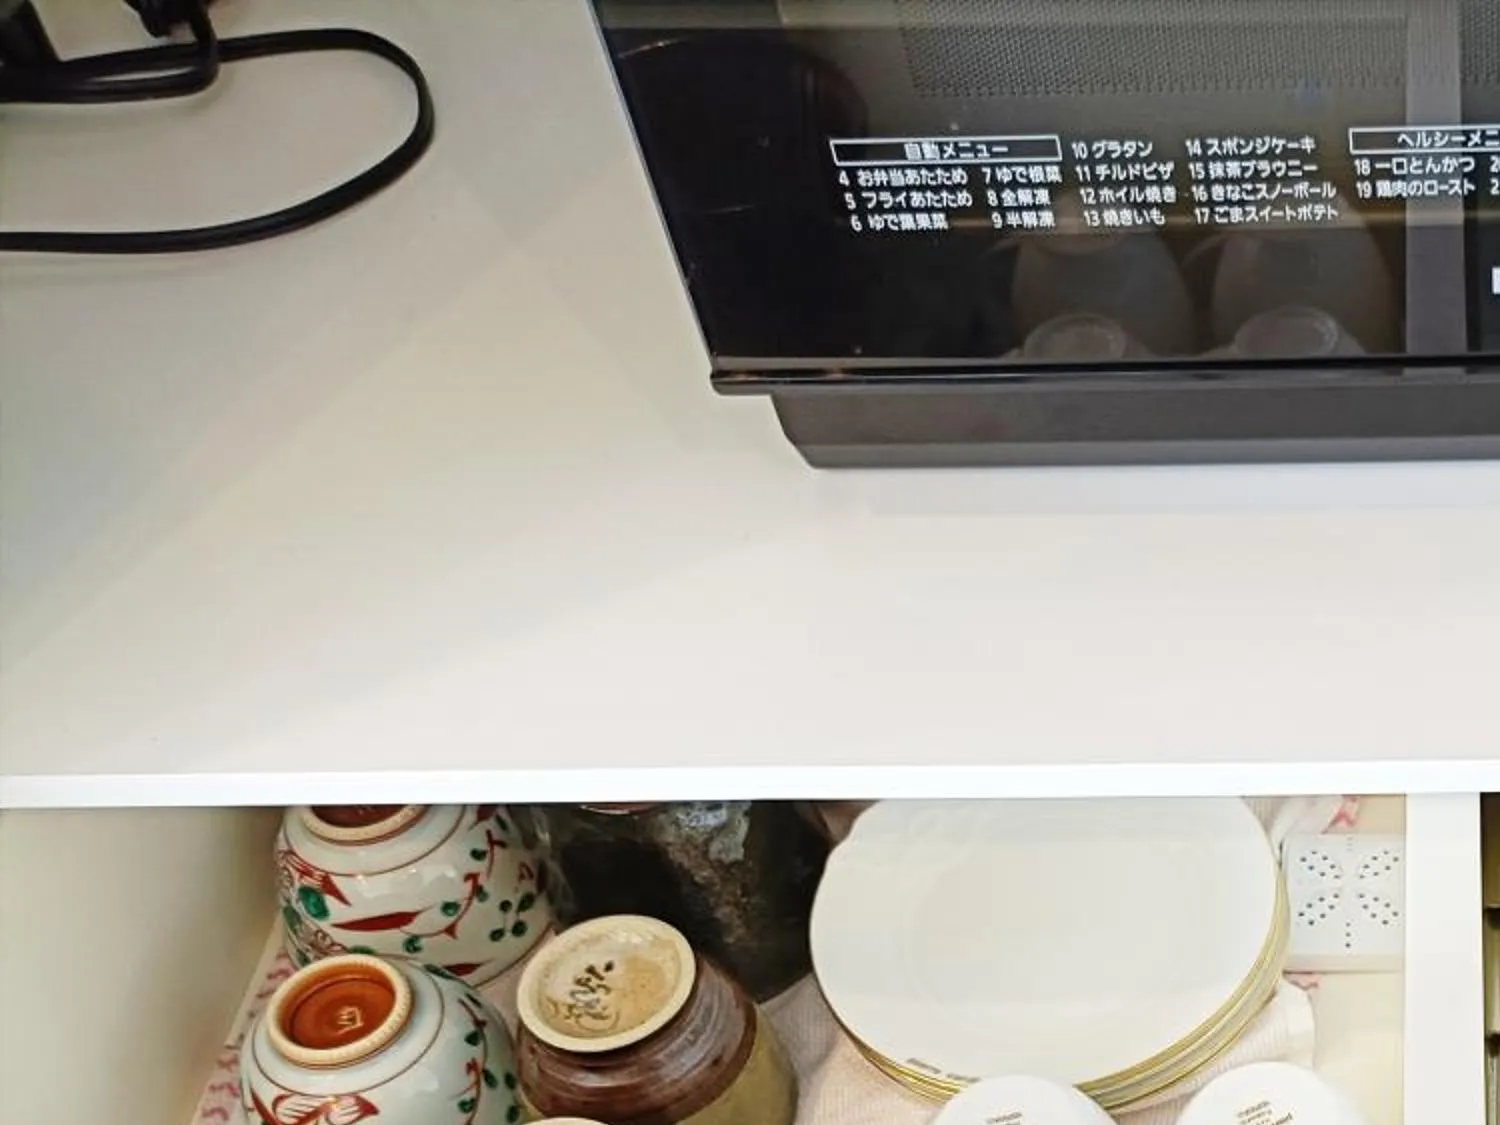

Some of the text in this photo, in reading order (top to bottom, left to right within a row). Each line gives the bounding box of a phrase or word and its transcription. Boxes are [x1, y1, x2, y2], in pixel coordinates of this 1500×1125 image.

[903, 141, 1009, 161] 自動メニュー
[1071, 140, 1154, 160] 10 グラタン
[1185, 135, 1317, 156] 14 スポンジケーキ
[982, 167, 991, 184] 7
[1074, 162, 1175, 182] 11 チルドピザ
[1187, 162, 1205, 180] 15
[1354, 156, 1476, 176] 18 一口とんかつ
[839, 167, 969, 187] 4 お弁当あたため
[986, 190, 997, 207] 8
[1079, 187, 1097, 205] 12
[1191, 181, 1337, 202] 16 きなこスノーボール
[1355, 181, 1373, 198] 19
[844, 190, 974, 210] 5 フライあたため
[851, 214, 863, 232] 6
[991, 212, 1003, 229] 9
[1083, 210, 1100, 227] 13
[1194, 203, 1339, 225] 17 ごまスイートポテト
